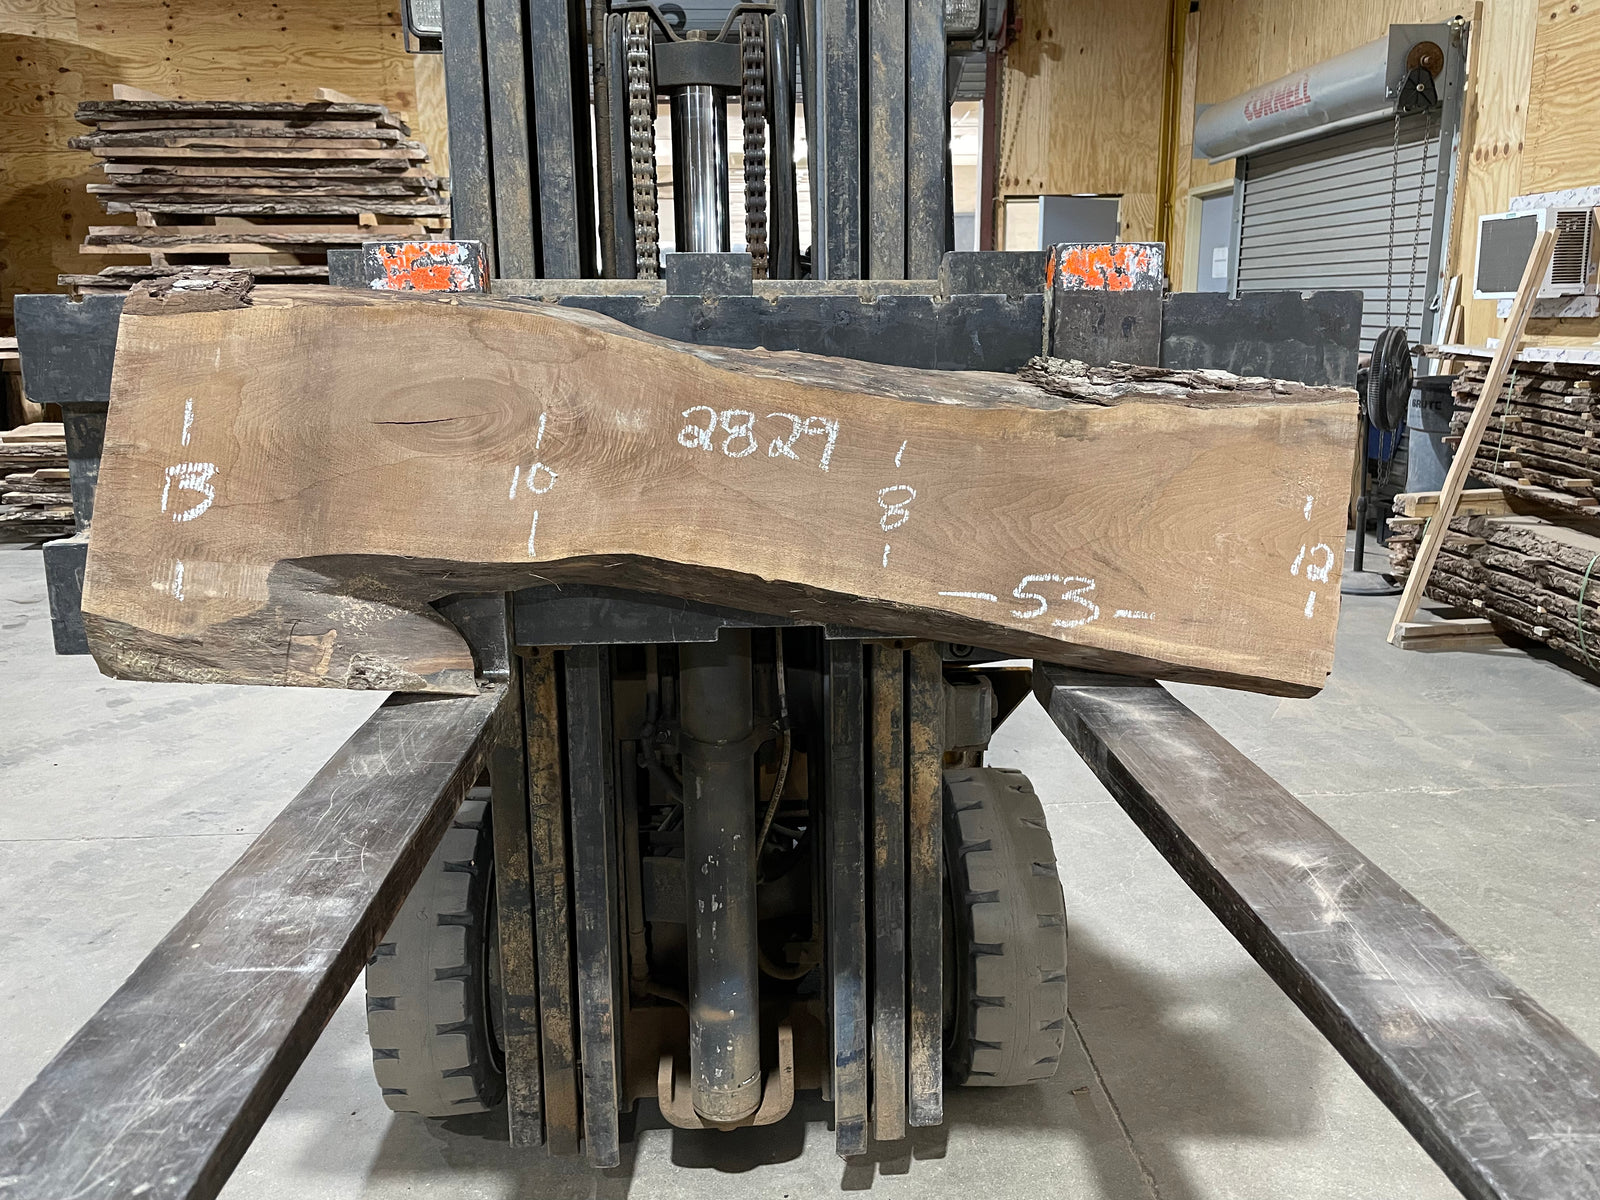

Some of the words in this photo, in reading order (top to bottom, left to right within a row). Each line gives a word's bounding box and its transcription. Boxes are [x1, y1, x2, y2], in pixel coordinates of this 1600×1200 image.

[1244, 79, 1311, 121] CORNELL
[678, 405, 840, 472] 2829
[509, 462, 559, 500] 10
[877, 485, 917, 531] 8
[1290, 542, 1334, 584] 12
